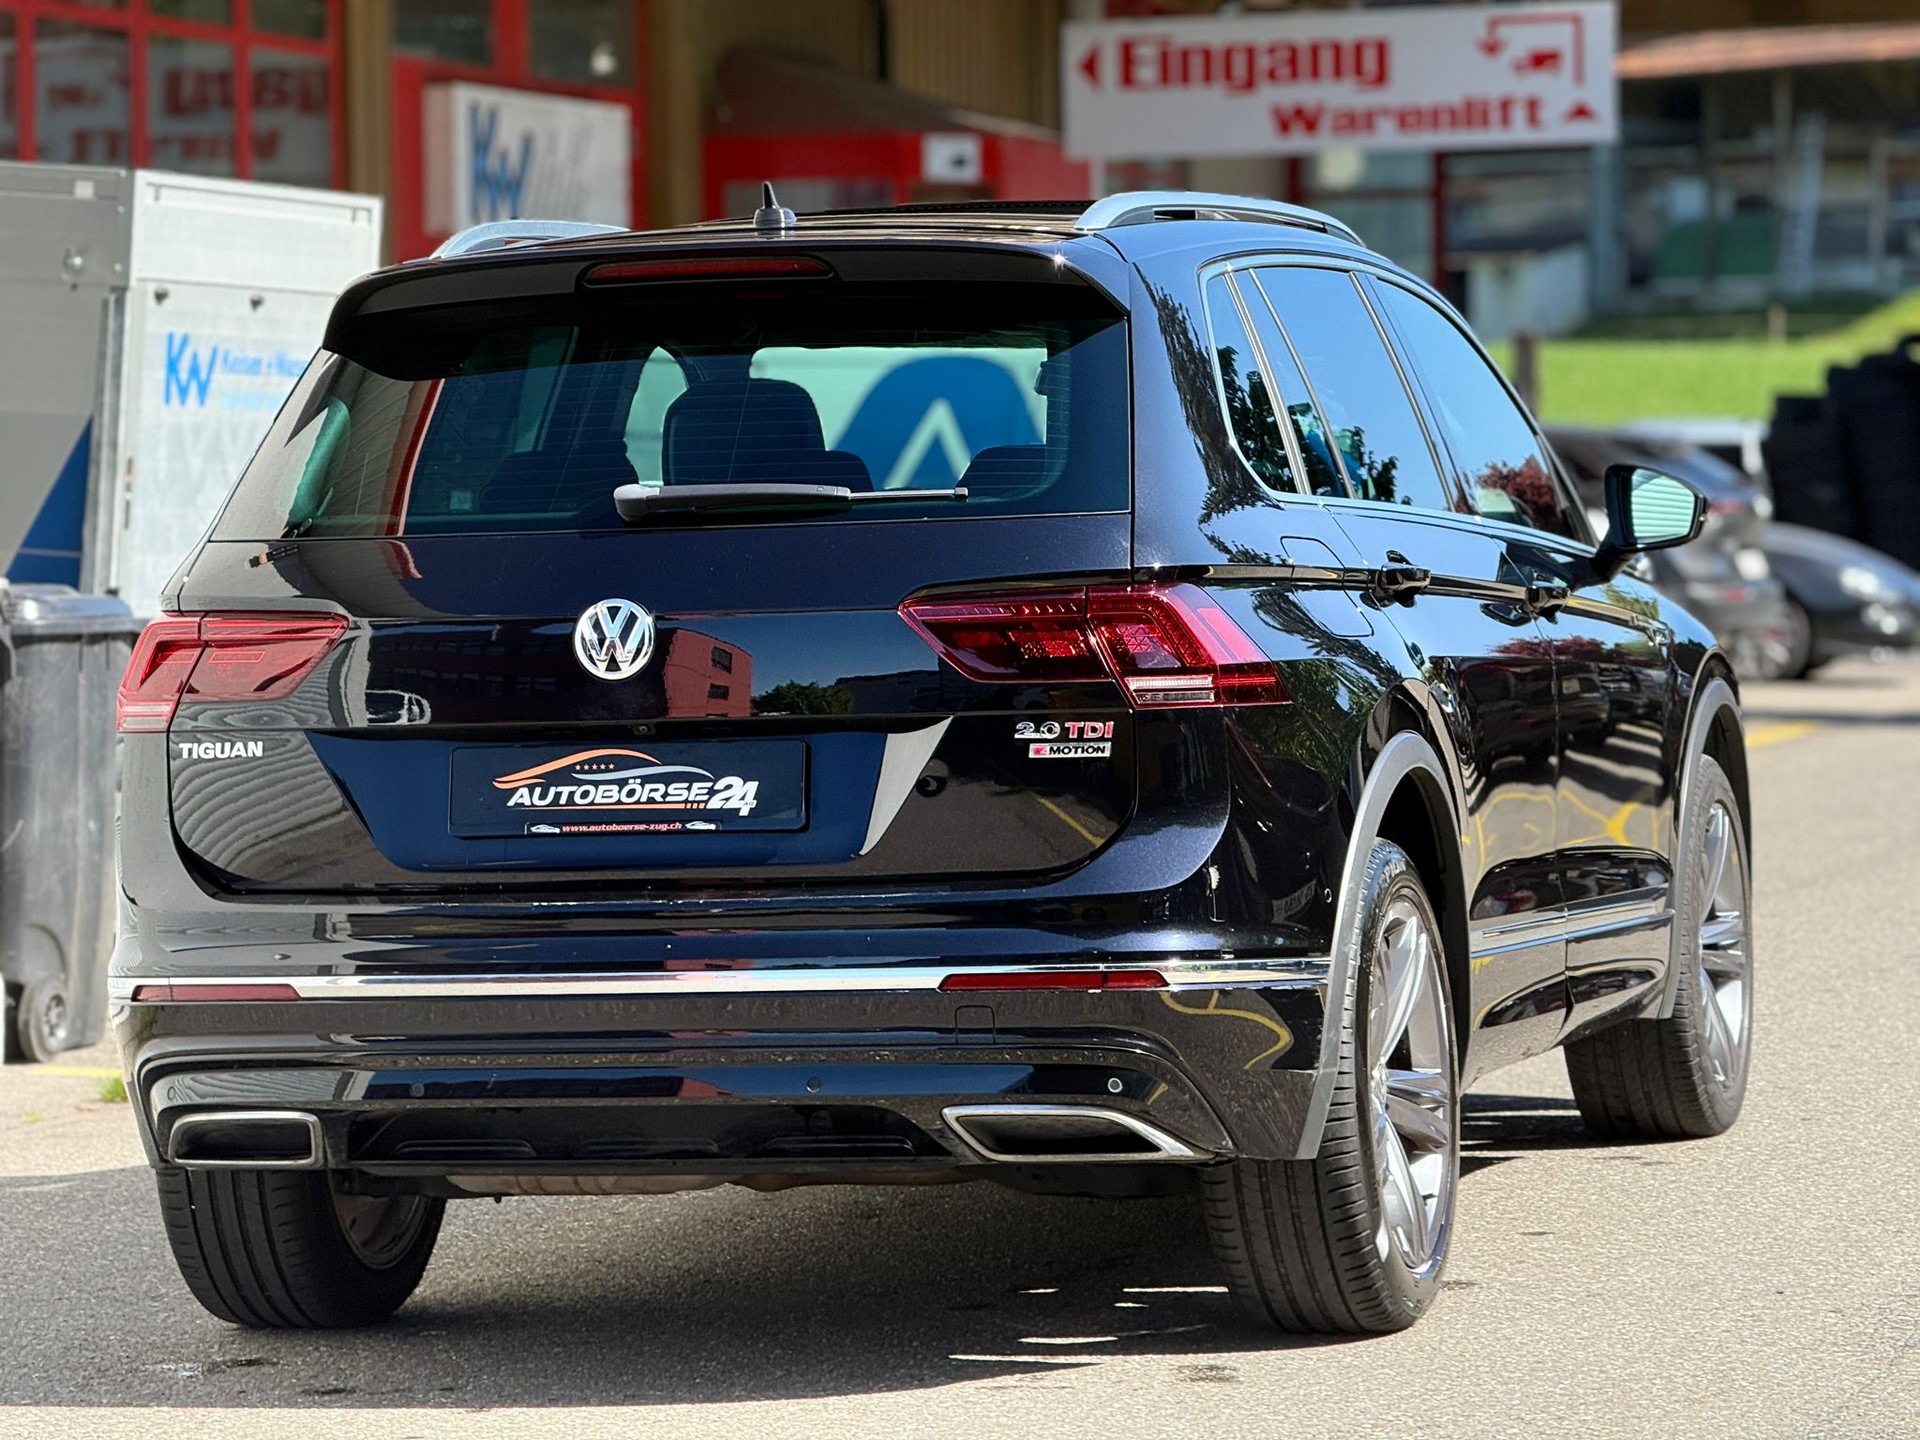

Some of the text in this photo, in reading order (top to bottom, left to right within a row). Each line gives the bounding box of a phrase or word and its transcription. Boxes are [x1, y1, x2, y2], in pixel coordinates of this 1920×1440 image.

[1117, 34, 1391, 93] Eingang
[1270, 95, 1548, 138] Warenlift
[1014, 721, 1115, 739] 2.0 TDI
[178, 741, 264, 759] TIGUAN
[562, 822, 682, 832] www.autoboerse-zug.ch
